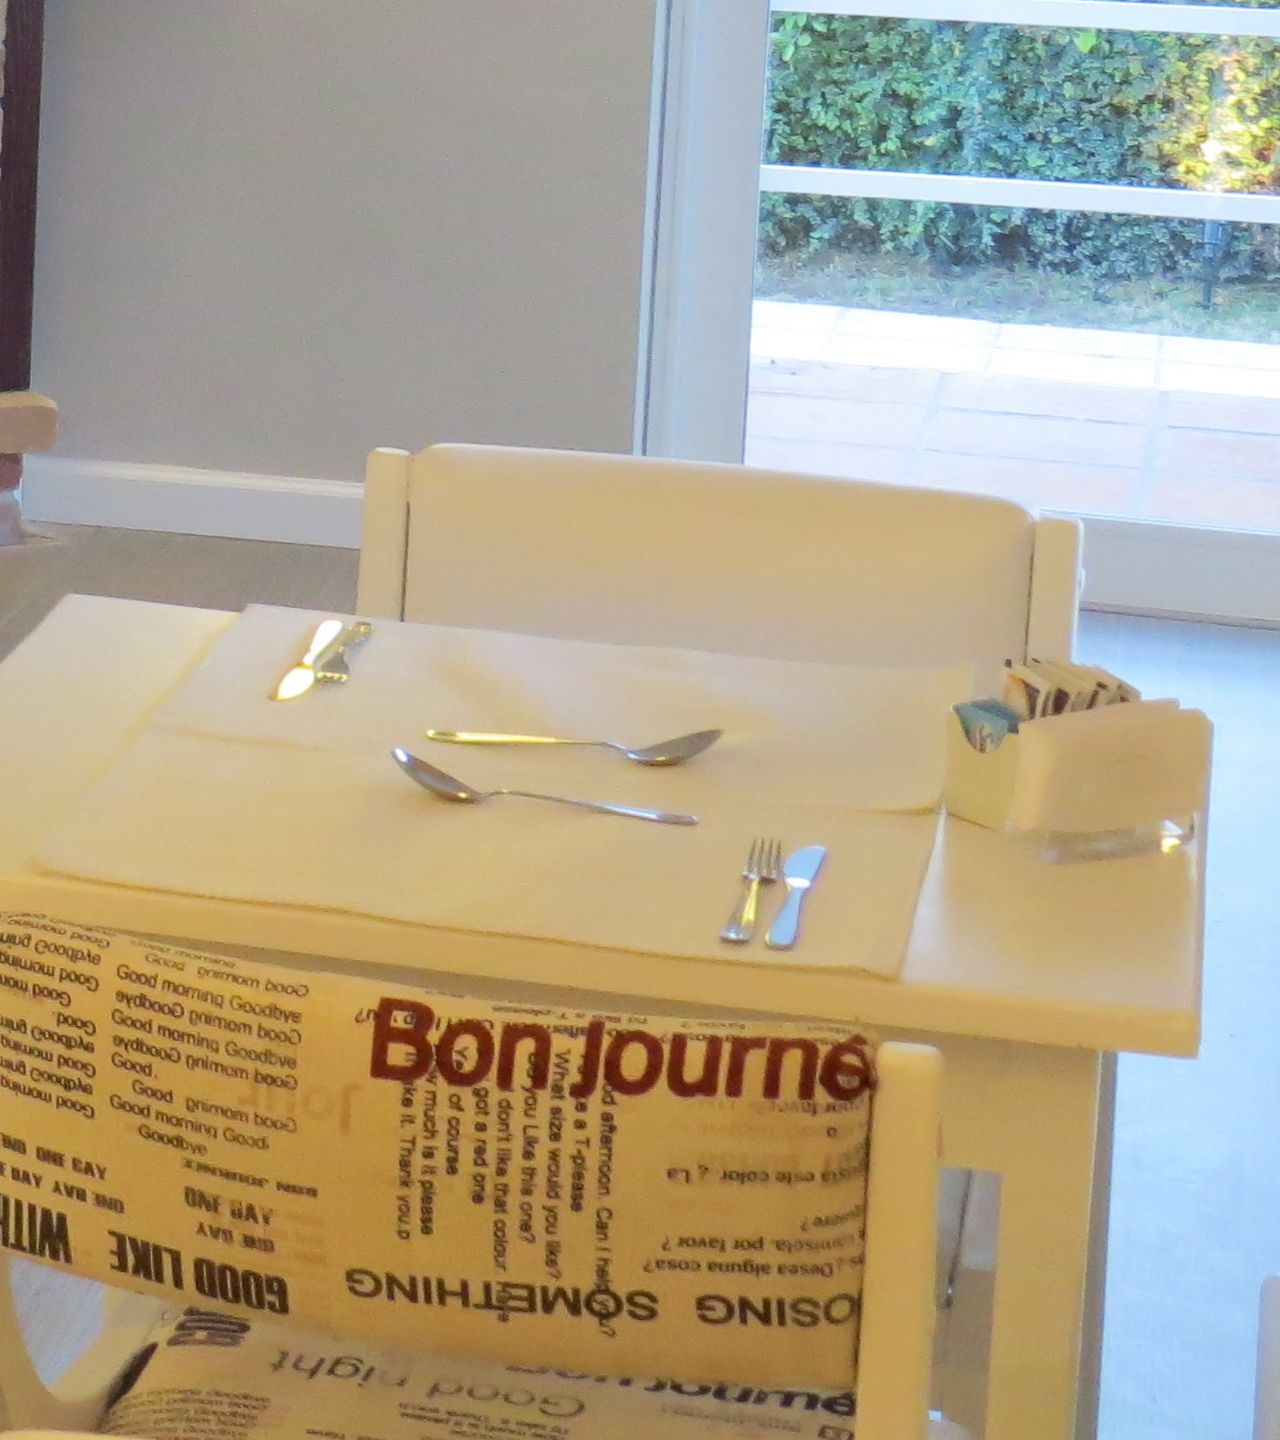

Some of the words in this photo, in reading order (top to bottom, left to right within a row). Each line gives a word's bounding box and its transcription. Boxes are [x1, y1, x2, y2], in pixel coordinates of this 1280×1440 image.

[32, 983, 71, 1008] Good
[59, 967, 100, 992] Good
[117, 964, 158, 989] Good
[162, 978, 224, 1009] morning
[229, 995, 302, 1024] Goodbye
[111, 1008, 153, 1034] Good
[157, 1023, 220, 1054] morning
[224, 1040, 297, 1070] Goodbye
[57, 1054, 97, 1079] Good
[111, 1052, 159, 1078] Good.
[132, 1079, 174, 1103] Good
[449, 1093, 465, 1113] of
[471, 1087, 490, 1116] got
[55, 1095, 95, 1120] Good
[109, 1094, 151, 1118] Good
[155, 1110, 218, 1139] morning
[423, 1090, 439, 1141] much
[498, 1098, 514, 1143] don't
[138, 1124, 207, 1156] Goodbye
[548, 1106, 568, 1143] size
[446, 1117, 461, 1176] course
[472, 1139, 488, 1168] red
[521, 1123, 539, 1162] Like
[399, 1136, 417, 1188] Thank
[496, 1148, 512, 1178] like
[546, 1149, 562, 1200] would
[570, 1137, 590, 1212] T-please
[471, 1173, 485, 1204] one
[494, 1182, 510, 1214] that
[520, 1166, 536, 1198] this
[418, 1179, 434, 1236] please
[519, 1201, 537, 1244] one?
[542, 1204, 559, 1235] you
[596, 1206, 614, 1241] Can
[107, 1229, 184, 1290] LIKE
[677, 1236, 726, 1252] favor
[733, 1236, 764, 1251] por
[544, 1240, 563, 1281] like?
[644, 1258, 702, 1273] cosa?
[707, 1259, 772, 1277] alguna
[193, 1257, 289, 1315] GOOD
[346, 1267, 659, 1323] SOMETHING
